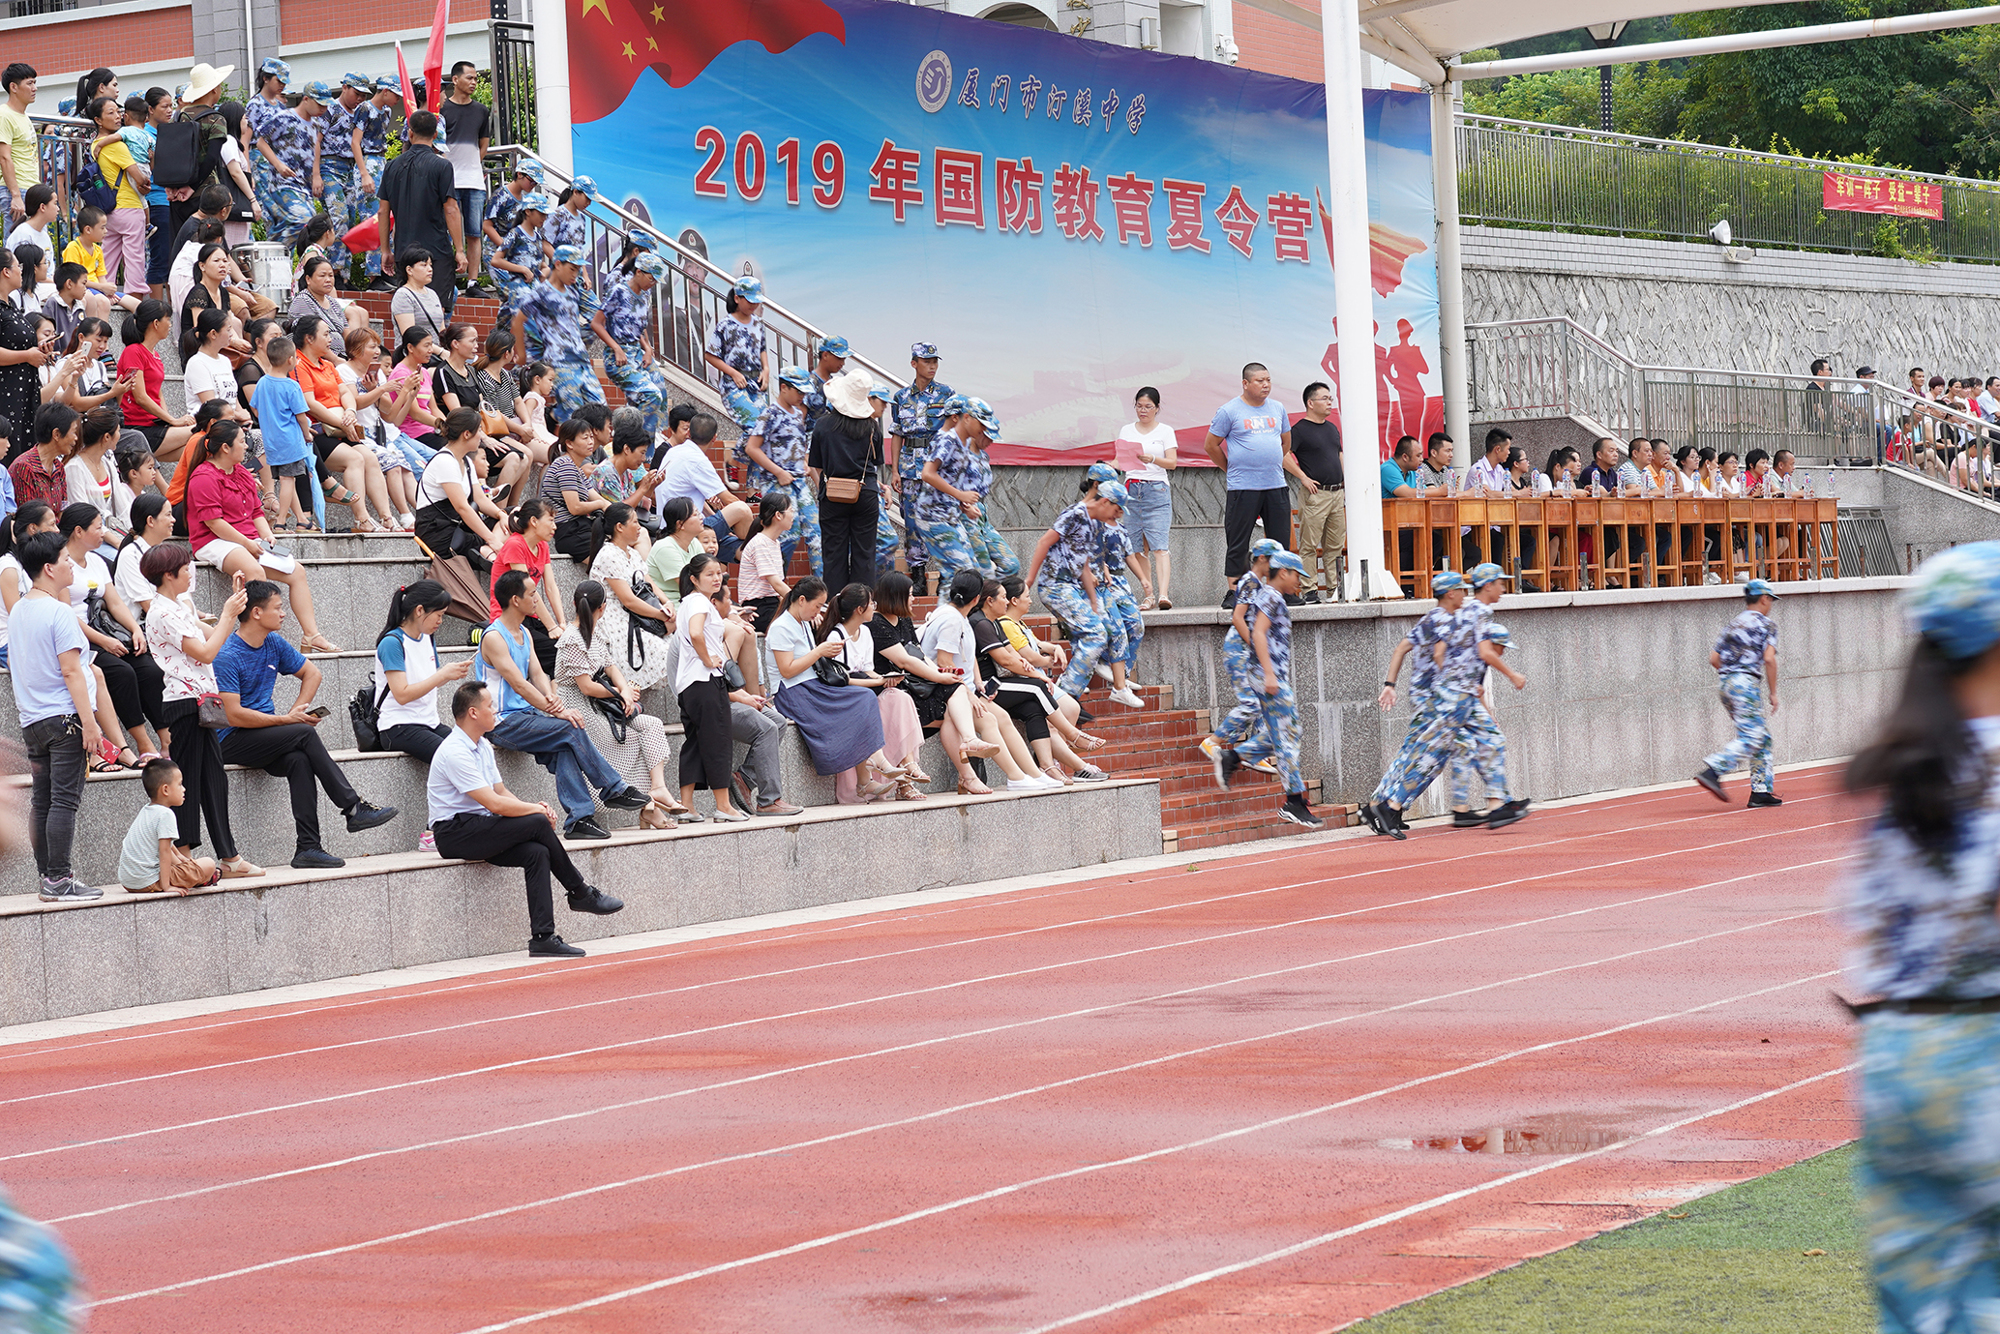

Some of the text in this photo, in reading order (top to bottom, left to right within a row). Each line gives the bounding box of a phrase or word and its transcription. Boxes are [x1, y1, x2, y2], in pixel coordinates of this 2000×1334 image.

[958, 67, 1146, 134] 厦门市汀溪中学
[695, 125, 1313, 263] 2019 年国防教育夏令营
[1888, 181, 1930, 205] 受益一辈子
